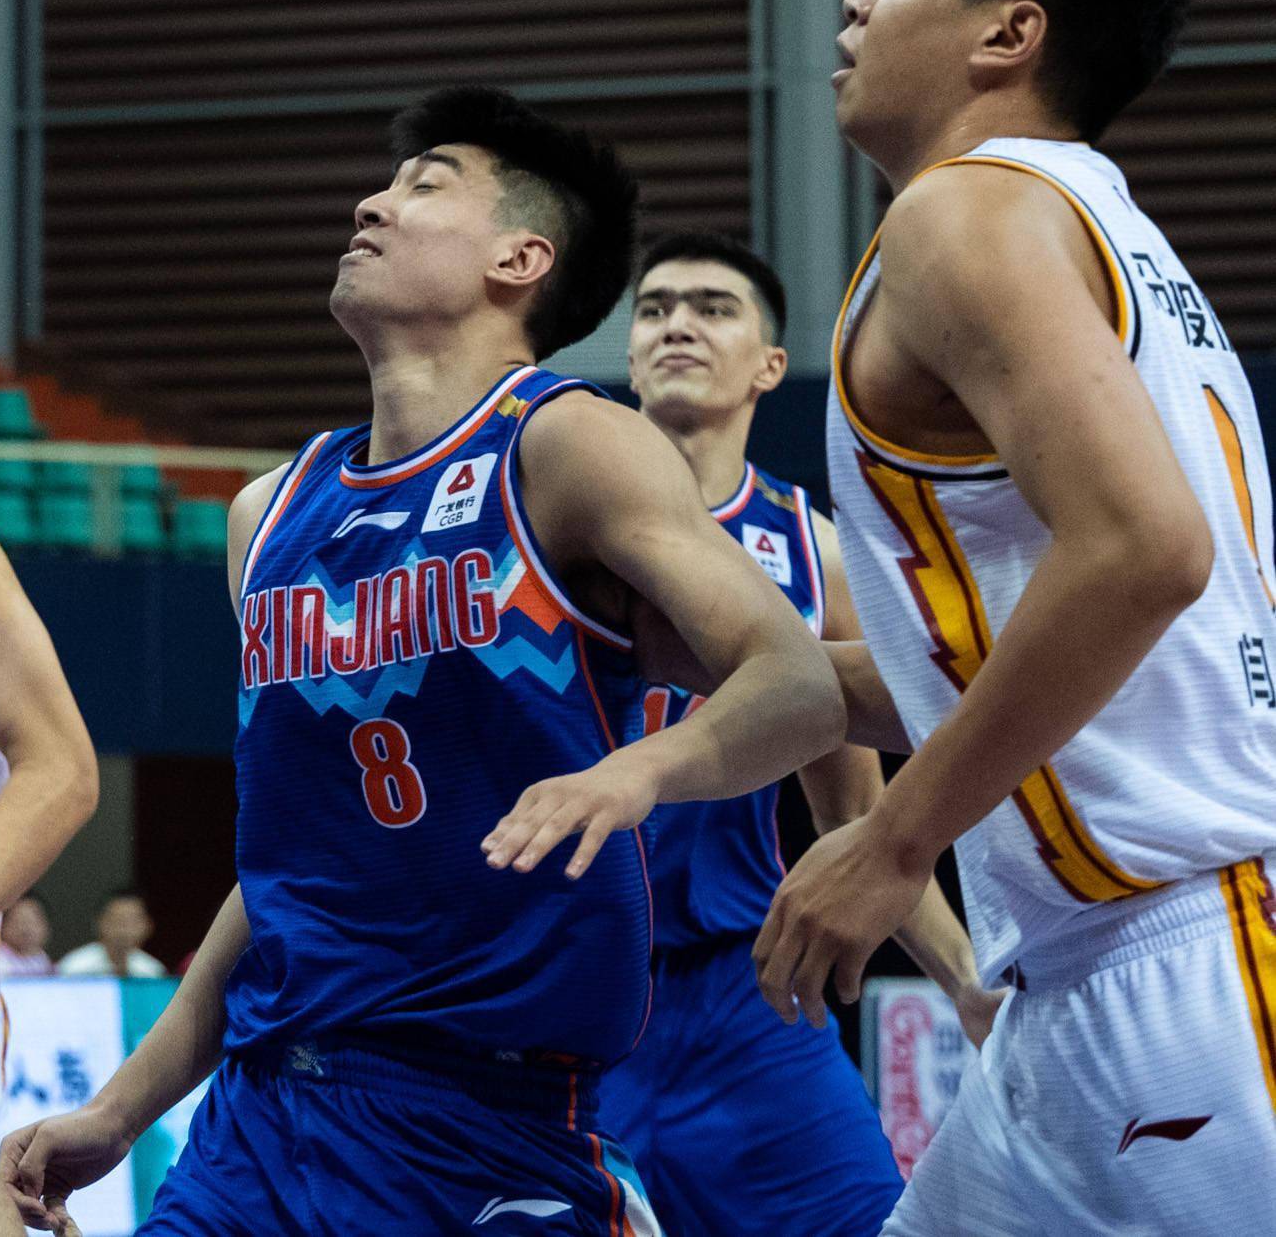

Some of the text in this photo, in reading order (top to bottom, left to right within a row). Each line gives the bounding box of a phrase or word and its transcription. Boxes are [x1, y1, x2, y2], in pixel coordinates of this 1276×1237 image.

[440, 511, 464, 527] CGB
[242, 548, 501, 691] XINJIANG
[349, 717, 427, 829] 8
